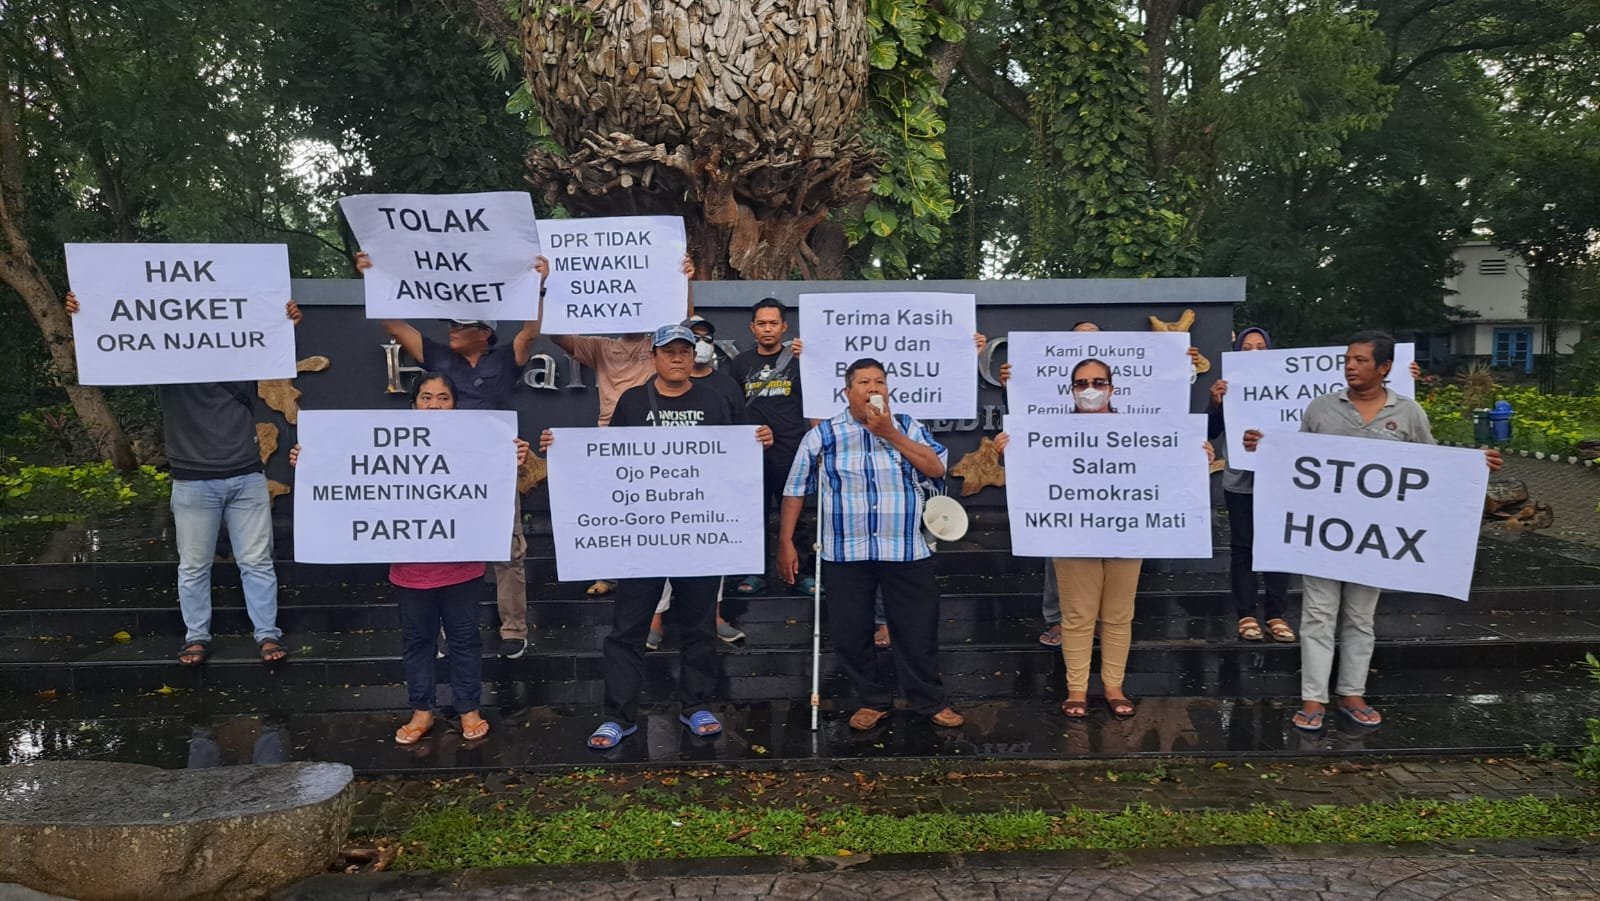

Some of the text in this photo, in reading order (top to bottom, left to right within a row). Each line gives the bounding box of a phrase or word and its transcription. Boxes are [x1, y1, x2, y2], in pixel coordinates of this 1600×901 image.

[377, 207, 490, 233] TOLAK
[550, 230, 652, 249] DPR TIDAK
[414, 250, 473, 272] HAK
[555, 255, 649, 272] MEWAKILI
[145, 260, 217, 283] HAK
[396, 279, 506, 304] ANGKET
[570, 279, 637, 295] SUARA
[110, 298, 248, 322] ANGKET
[566, 302, 643, 319] RAKYAT
[823, 309, 953, 326] Terima Kasih
[97, 331, 266, 353] ORA NJALUR
[845, 335, 931, 352] KPU dan
[1045, 344, 1145, 360] Kami Dukung
[835, 361, 940, 378] BASLU
[1036, 365, 1068, 378] KPU
[1243, 384, 1289, 402] HAK
[373, 426, 432, 448] DPR
[1027, 431, 1178, 448] Pemilu Selesai
[586, 440, 727, 457] PEMILU JURDIL
[351, 454, 451, 476] HANYA
[615, 465, 700, 483] Ojo Pecah
[1072, 457, 1136, 475] Salam
[1292, 456, 1430, 502] STOP
[312, 483, 488, 501] MEMENTINGKAN
[611, 488, 705, 506] Ojo Bubrah
[1048, 484, 1159, 501] Demokrasi
[577, 510, 739, 528] Goro-Goro Pemilu...
[1025, 512, 1186, 533] NKRI Harga Mati
[352, 518, 456, 541] PARTAI
[1283, 511, 1428, 563] HOAX
[574, 531, 742, 550] KABEH DULUR NDA...
